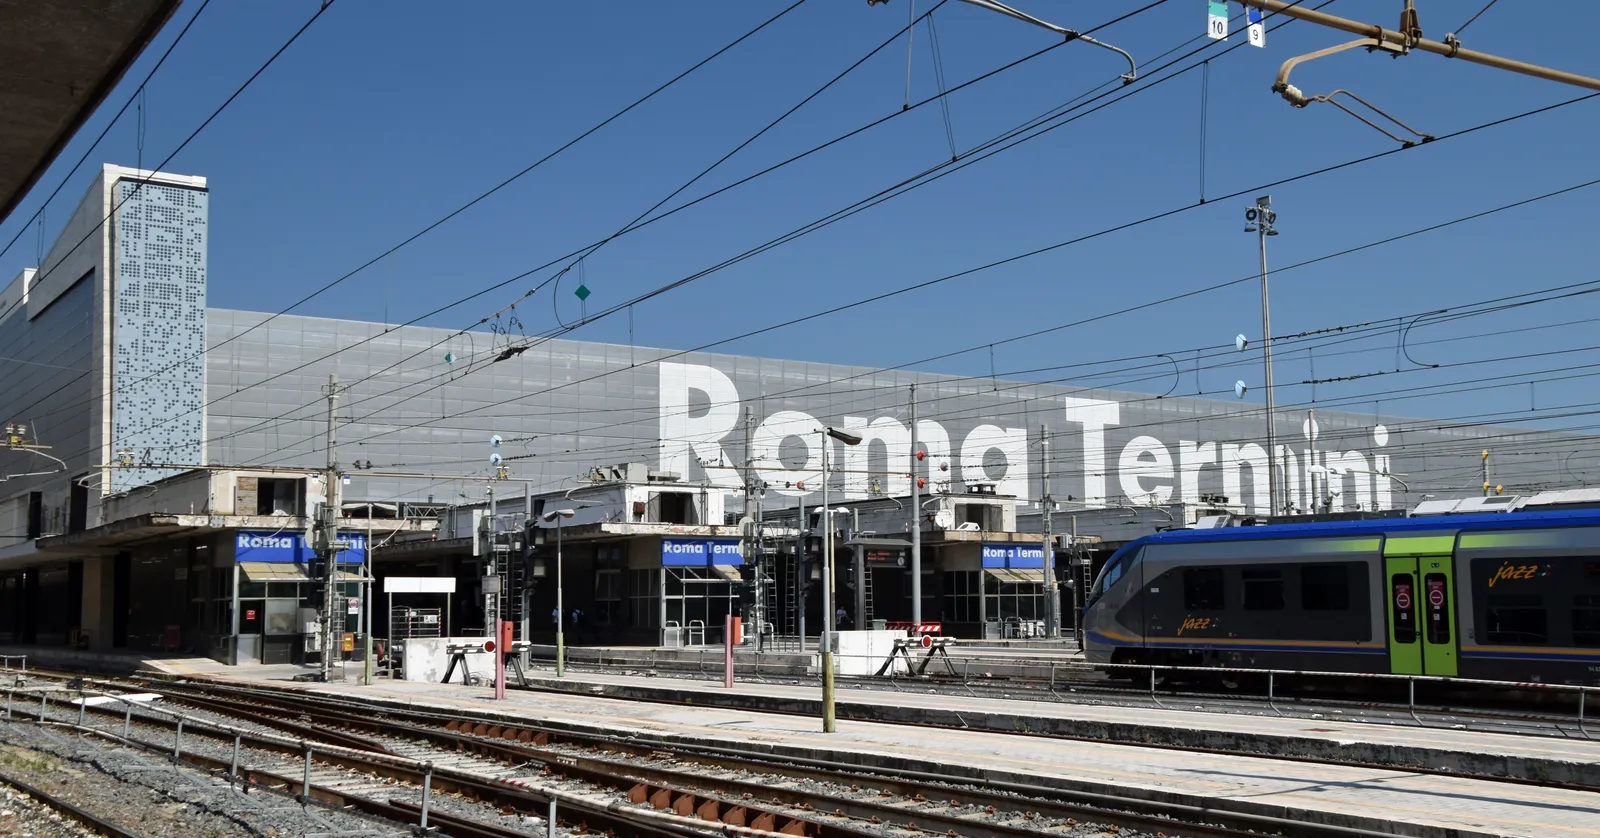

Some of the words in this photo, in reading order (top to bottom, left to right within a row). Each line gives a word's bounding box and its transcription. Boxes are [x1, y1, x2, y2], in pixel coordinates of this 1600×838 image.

[1212, 20, 1223, 35] 10
[1252, 29, 1259, 41] 9
[659, 361, 1029, 506] Roma
[1065, 397, 1393, 516] Termini
[238, 533, 292, 549] Roma
[663, 541, 704, 554] Roma
[706, 541, 740, 554] Term
[983, 546, 1014, 558] Roma
[1488, 560, 1539, 588] jazz
[1177, 613, 1211, 636] jazz
